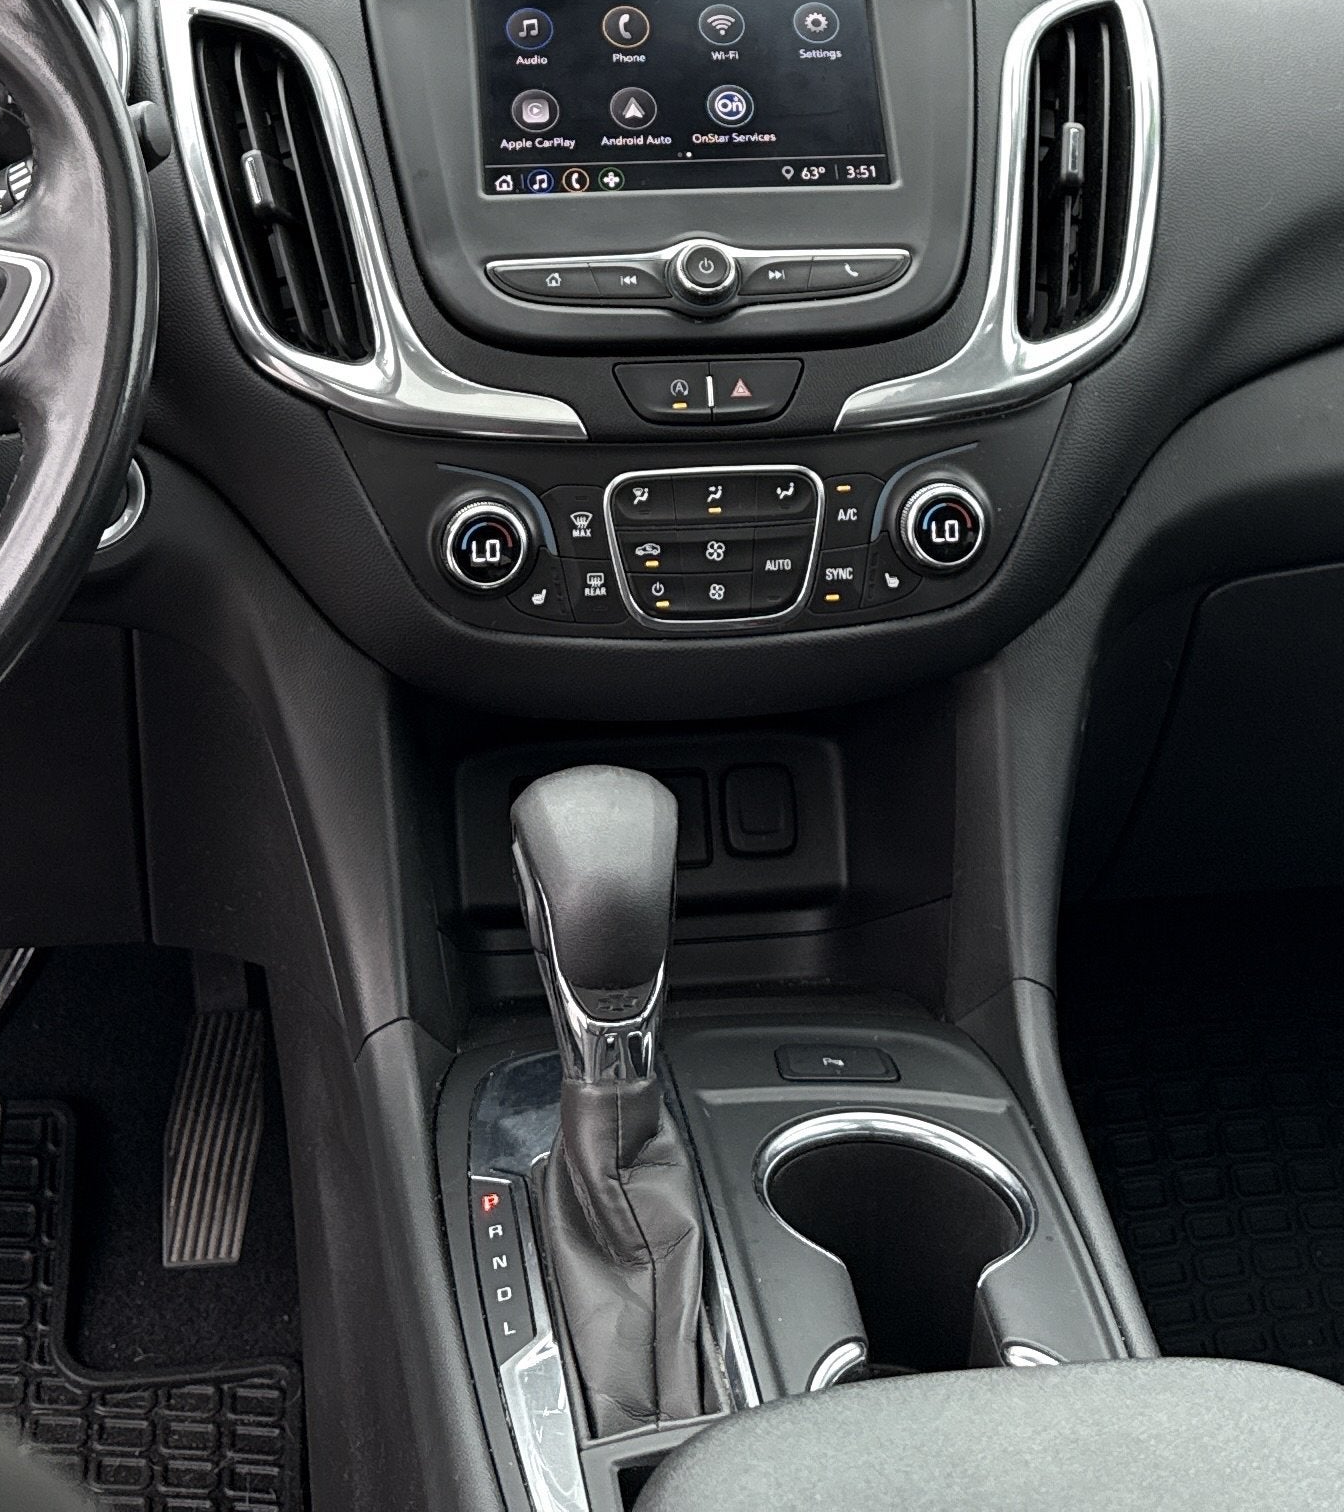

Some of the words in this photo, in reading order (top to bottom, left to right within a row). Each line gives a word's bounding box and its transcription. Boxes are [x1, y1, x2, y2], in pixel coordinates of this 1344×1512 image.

[516, 55, 548, 66] Audio
[612, 52, 646, 63] Phone
[711, 50, 739, 61] Wi-Fi
[799, 48, 842, 61] Settings
[718, 97, 743, 112] On
[500, 138, 531, 150] Apple
[534, 137, 575, 150] CarPlay
[601, 134, 640, 146] Android
[644, 135, 672, 146] Auto
[692, 133, 729, 143] OnStar
[732, 132, 776, 142] Services
[846, 165, 876, 179] 3:51
[837, 508, 857, 522] A/C
[572, 526, 592, 538] MAX
[931, 521, 959, 543] LO
[471, 539, 500, 562] LO
[764, 558, 792, 571] AUTO
[826, 568, 854, 581] SYNC
[585, 584, 607, 596] REAR
[483, 1193, 500, 1212] P
[488, 1224, 503, 1238] R
[492, 1254, 507, 1270] N
[497, 1287, 512, 1302] D
[503, 1321, 516, 1335] L
